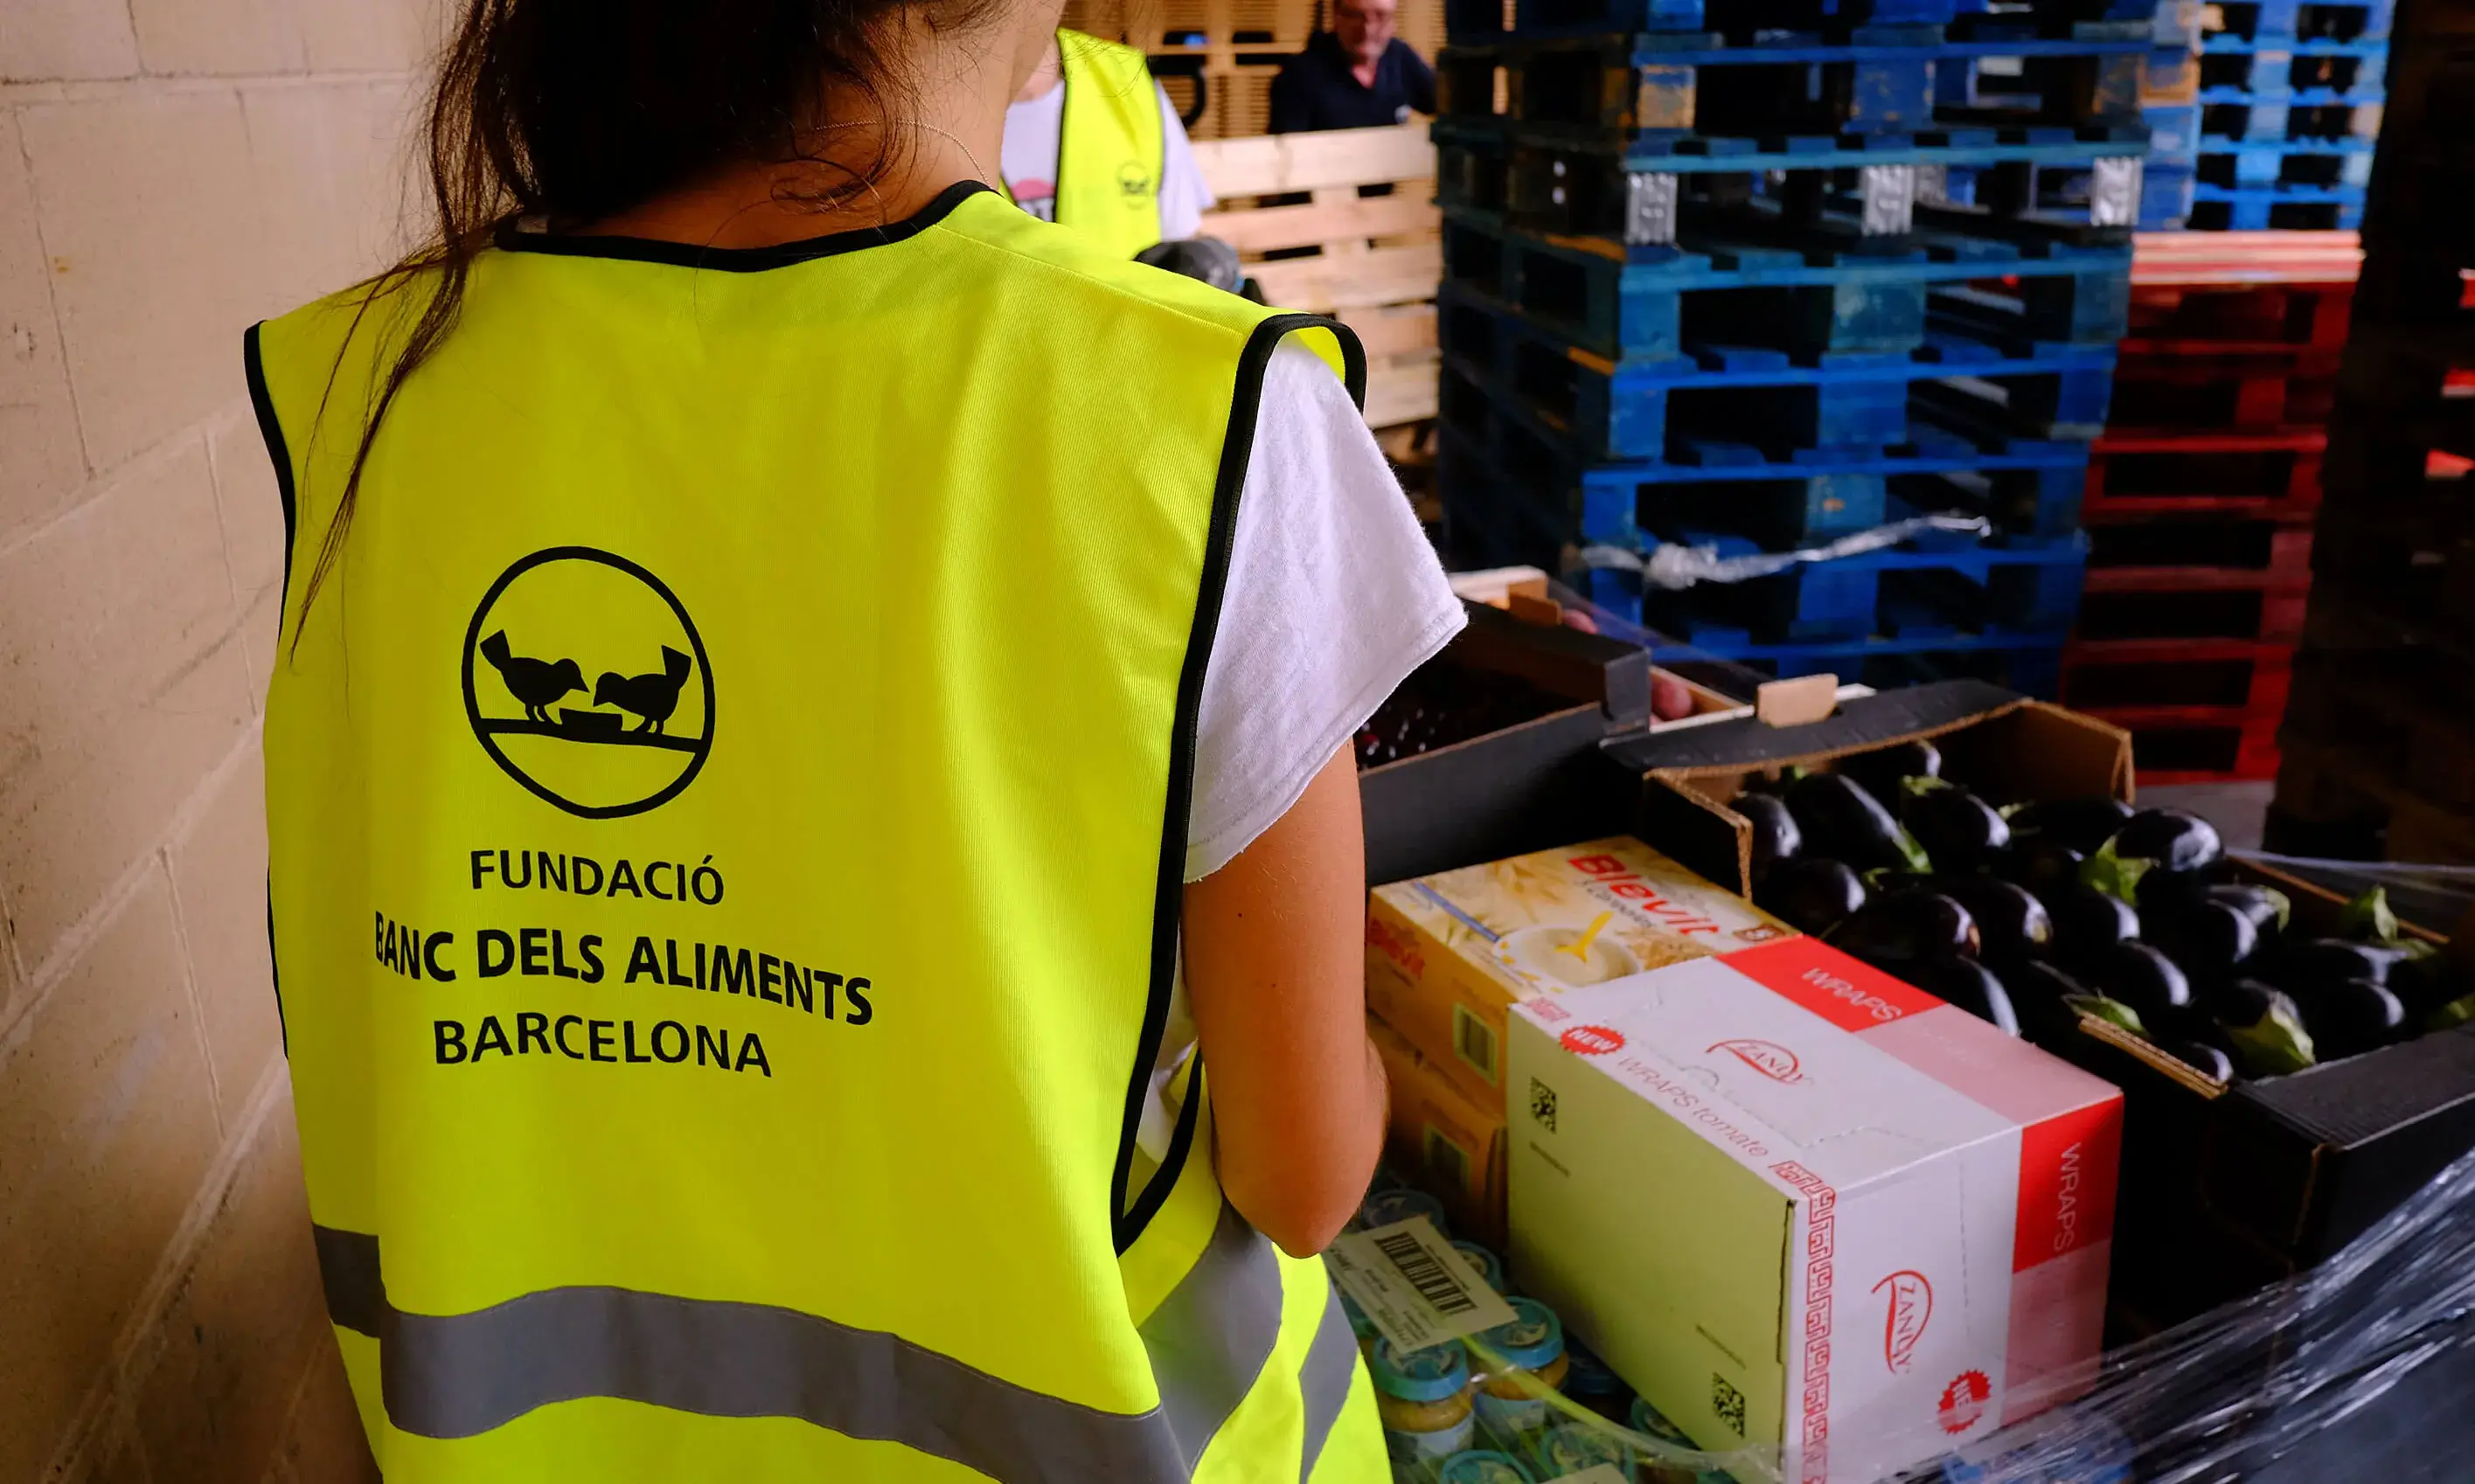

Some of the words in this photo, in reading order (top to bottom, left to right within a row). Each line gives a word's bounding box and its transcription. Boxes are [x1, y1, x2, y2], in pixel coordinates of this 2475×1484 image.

[470, 849, 726, 905] FUNDACIÓ
[1568, 854, 1720, 936] Blevit
[375, 910, 457, 982] BANC
[476, 927, 607, 984] DELS
[624, 936, 873, 1026] ALIMENTS
[1802, 966, 1903, 1021] WRAPS
[433, 1012, 772, 1078] BARCELONA
[1569, 1028, 1619, 1051] NEW
[1617, 1055, 1700, 1109] WRAPS
[1693, 1103, 1769, 1158] tomate
[2054, 1141, 2082, 1252] WRAPS
